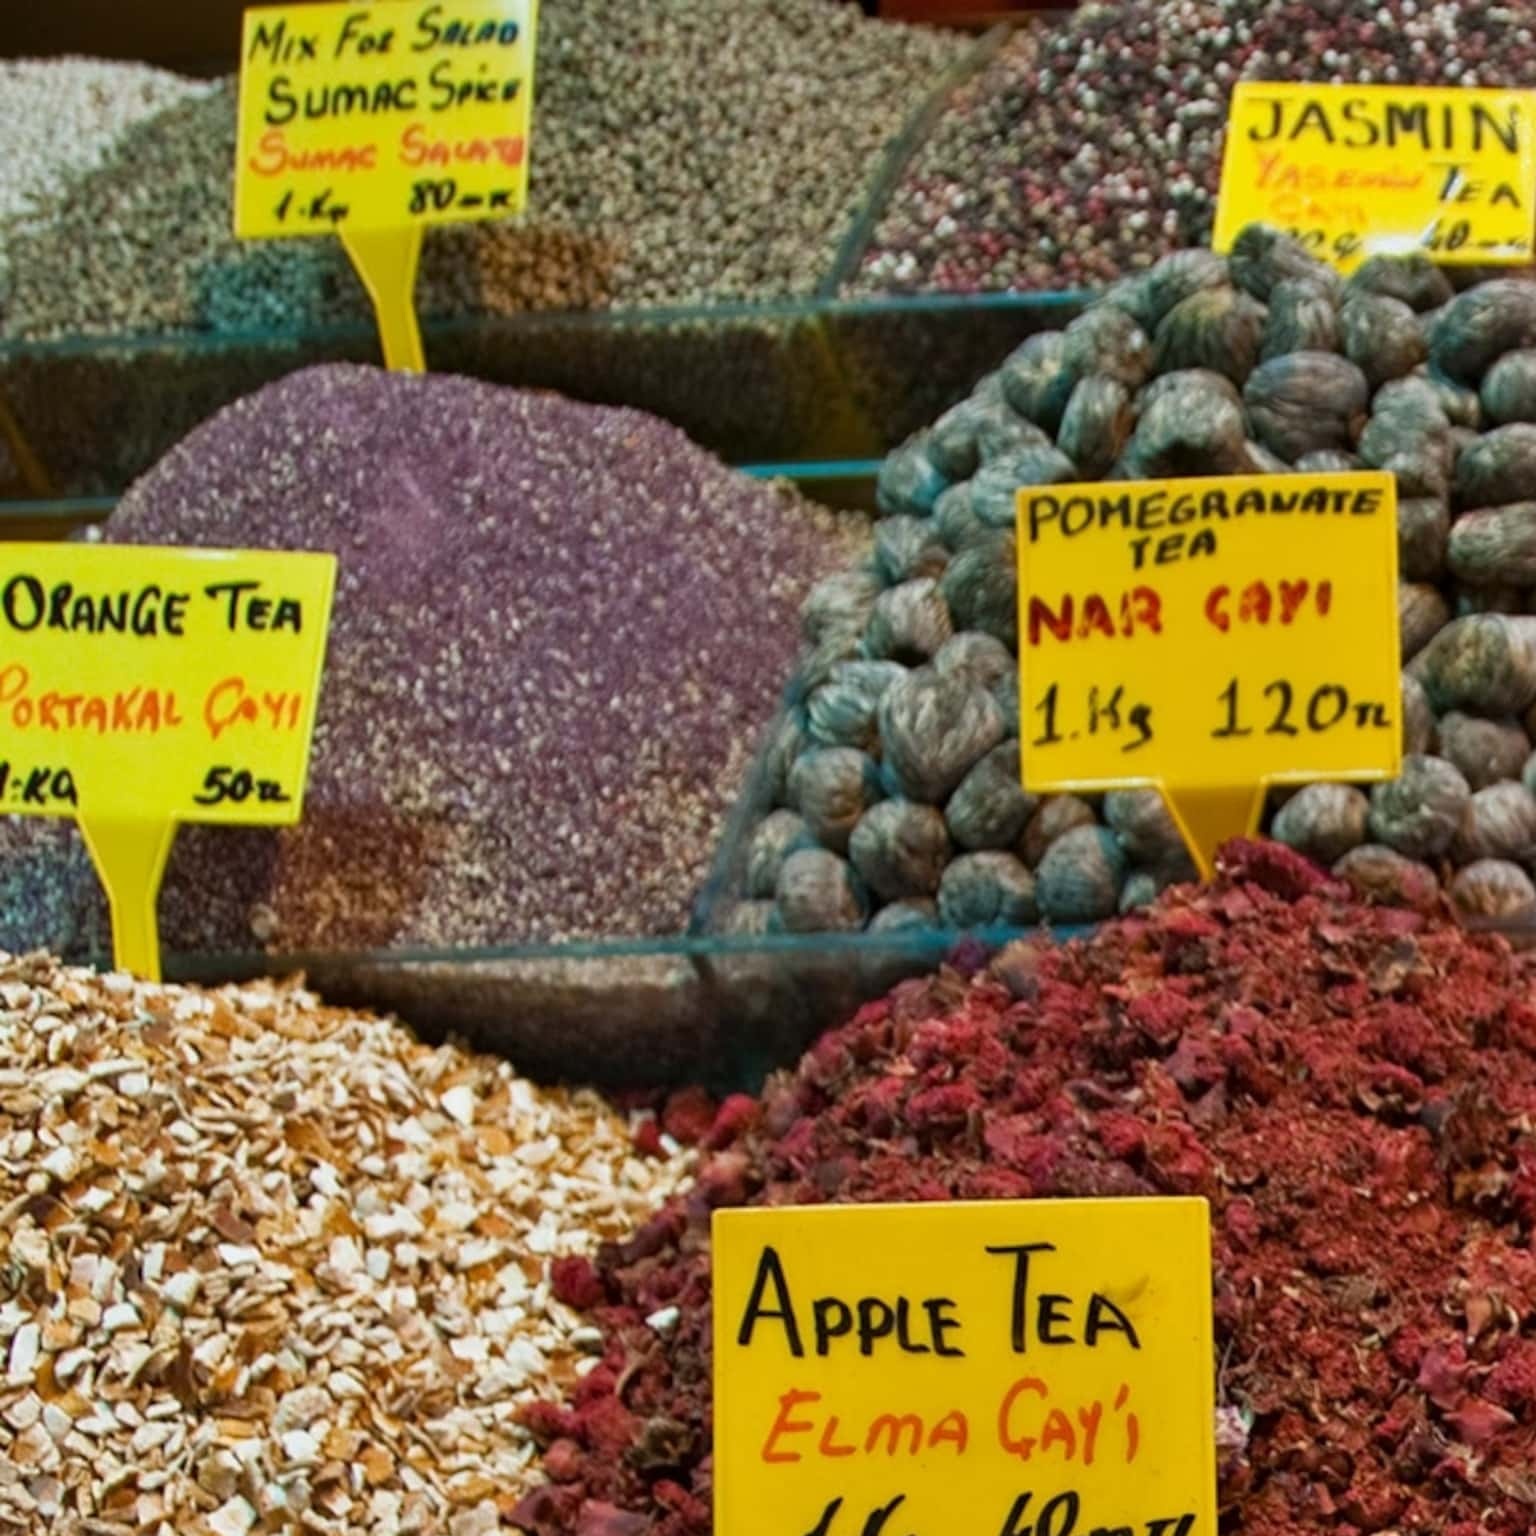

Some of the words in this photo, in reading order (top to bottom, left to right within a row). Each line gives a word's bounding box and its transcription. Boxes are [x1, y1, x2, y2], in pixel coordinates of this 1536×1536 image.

[1247, 97, 1520, 155] JASMIN
[1427, 161, 1522, 208] TEA
[1129, 528, 1219, 571] TEA
[2, 573, 190, 637] ORANGE
[204, 580, 303, 635] TEA
[1027, 585, 1163, 647] NAR
[737, 1245, 966, 1358] APPLE
[984, 1242, 1141, 1355] TEA
